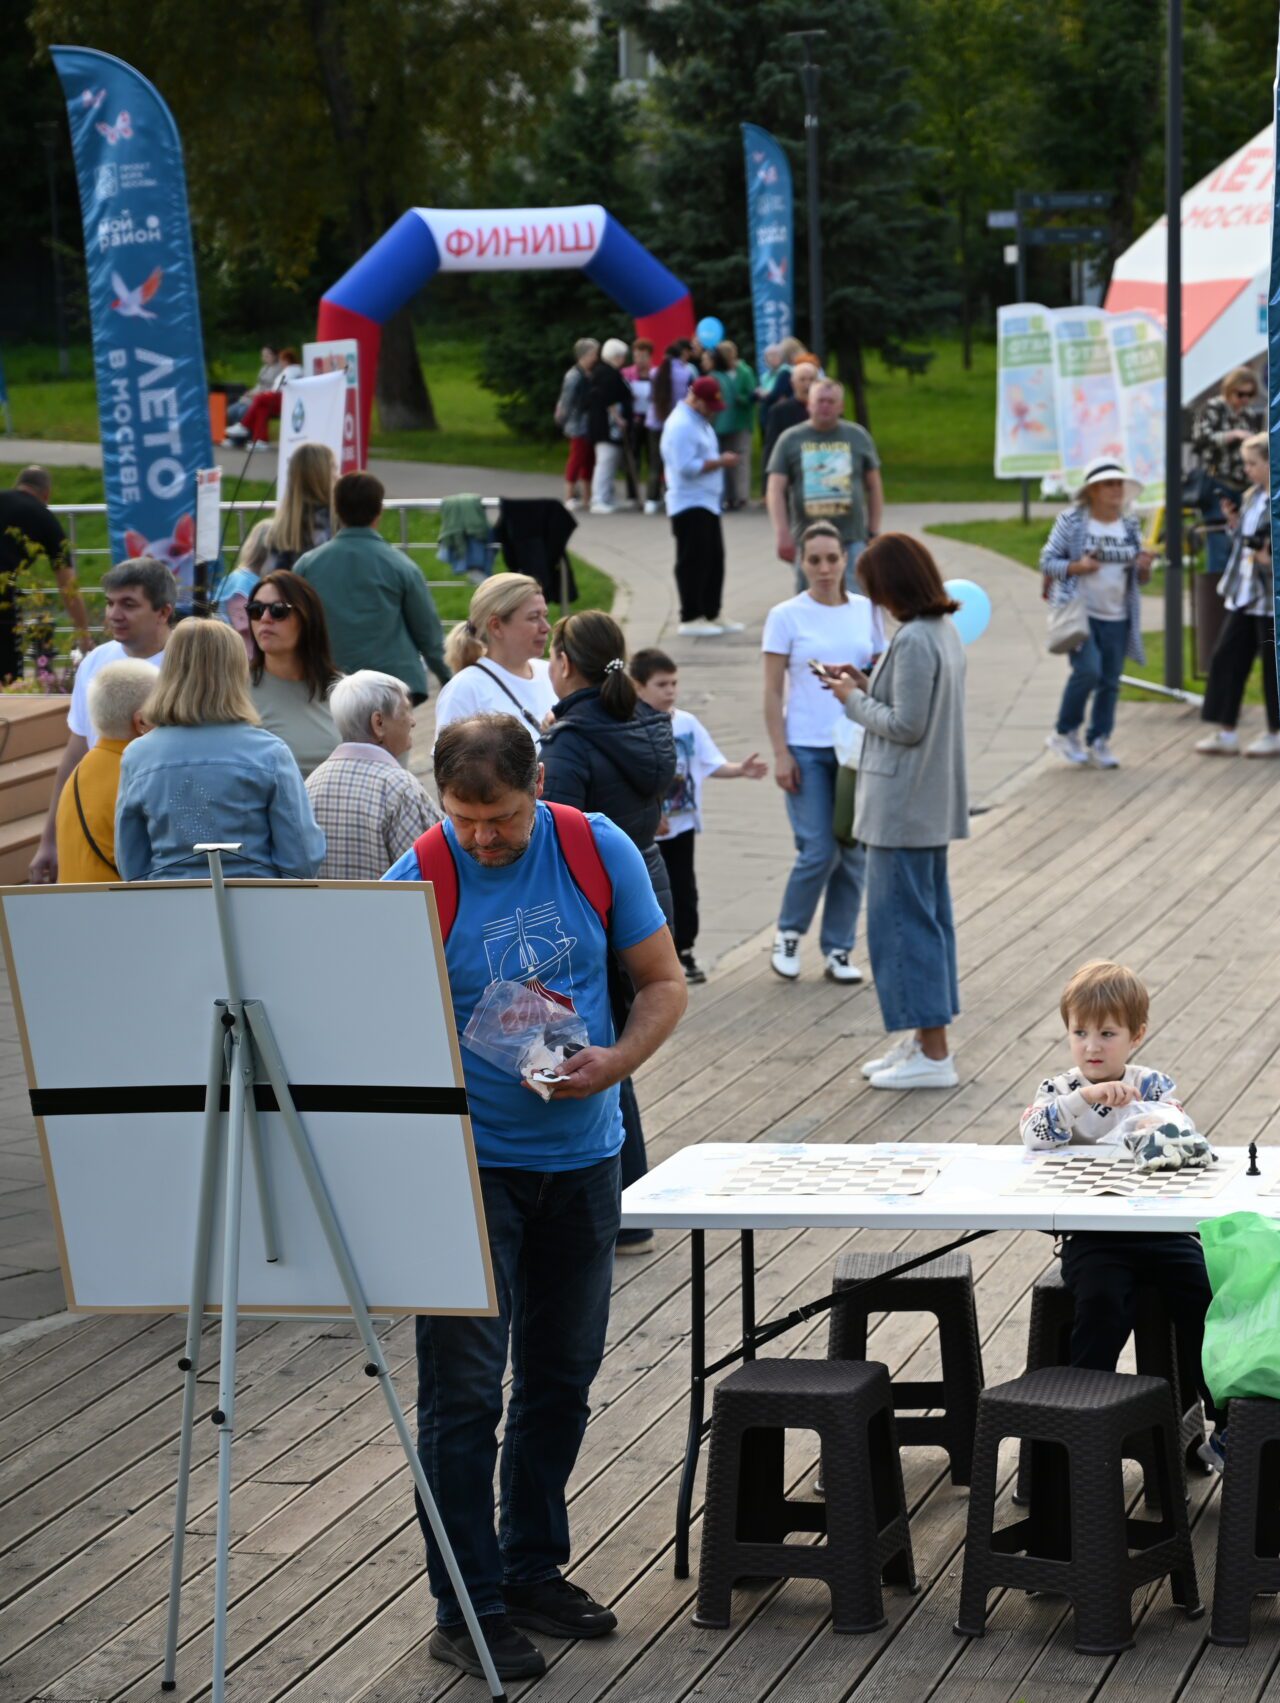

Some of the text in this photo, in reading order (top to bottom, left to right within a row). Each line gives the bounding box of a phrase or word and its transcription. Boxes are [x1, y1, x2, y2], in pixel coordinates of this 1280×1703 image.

[445, 221, 596, 258] ФИНИШ
[1189, 203, 1273, 230] МОСКВ
[108, 348, 141, 504] В МОСКВЕ
[134, 347, 187, 500] ЛЕТО
